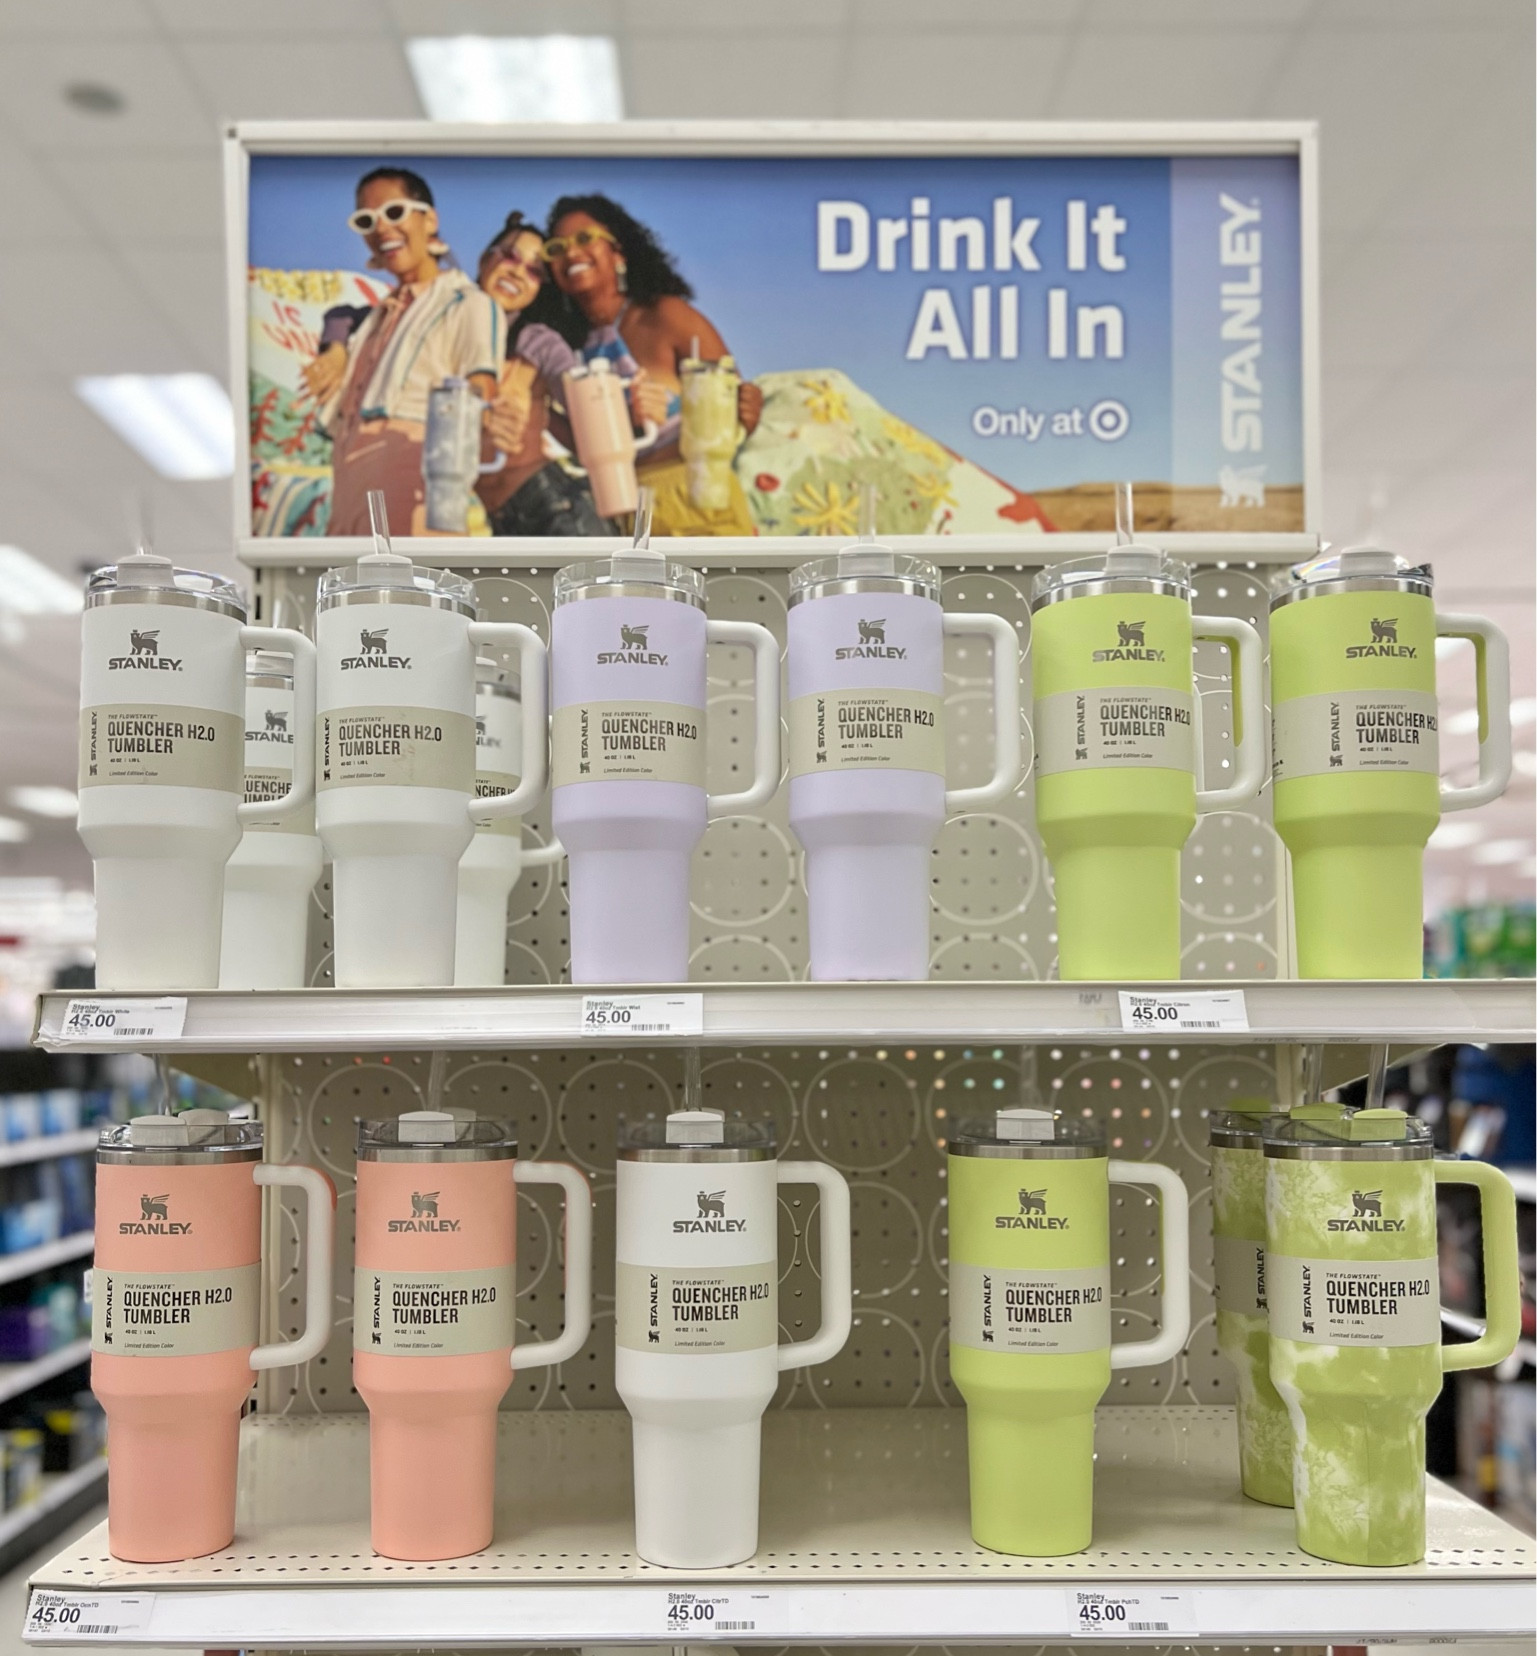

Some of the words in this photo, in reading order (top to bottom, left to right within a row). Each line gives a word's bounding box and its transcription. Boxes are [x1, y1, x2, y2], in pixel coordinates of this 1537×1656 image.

[817, 196, 1042, 273] Drink
[1066, 199, 1127, 273] It
[906, 285, 1020, 360] All
[1048, 288, 1125, 360] In
[1219, 192, 1263, 453] STANLEY
[972, 406, 1046, 443] Only
[1052, 408, 1084, 437] at
[597, 653, 668, 665] STANLEY
[835, 647, 907, 660] STANLEY
[1092, 649, 1165, 662] STANLEY
[1346, 646, 1417, 659] STANLEY
[108, 657, 183, 671] STANLEY
[340, 657, 412, 670] STANLEY
[838, 707, 911, 723] QUENCHER
[914, 710, 934, 727] H2.0
[1076, 696, 1085, 744] STANLEY
[1100, 705, 1172, 721] QUENCHER
[1356, 711, 1425, 728] QUENCHER
[602, 719, 674, 735] QUENCHER
[677, 723, 697, 739] H2.0
[817, 698, 825, 748] STANLEY
[1100, 723, 1165, 737] TUMBLER
[1331, 702, 1339, 752] STANLEY
[107, 721, 183, 738] QUENCHER
[187, 724, 215, 742] H2.0
[244, 731, 294, 744] STANLE
[339, 724, 410, 740] QUENCHER
[415, 725, 442, 741] H2.0
[580, 709, 588, 758] STANLEY
[838, 725, 903, 739] TUMBLER
[1356, 729, 1419, 744] TUMBLER
[107, 738, 173, 754] TUMBLER
[339, 741, 400, 757] TUMBLER
[602, 736, 666, 751] TUMBLER
[244, 780, 292, 794] UENCHE
[475, 785, 506, 797] NCHER
[72, 1004, 100, 1012] Stanley
[586, 1001, 613, 1009] Stanley
[69, 1014, 116, 1027] 45.00
[586, 1010, 631, 1023] 45.00
[1132, 1007, 1178, 1020] 45.00
[119, 1223, 193, 1235] STANLEY
[388, 1220, 461, 1232] STANLEY
[673, 1219, 746, 1233] STANLEY
[995, 1217, 1069, 1229] STANLEY
[1327, 1219, 1405, 1232] STANLEY
[1256, 1248, 1265, 1295] STANLEY
[672, 1286, 747, 1303] QUENCHER
[750, 1283, 769, 1299] H2.0
[1006, 1289, 1080, 1305] QUENCHER
[1083, 1287, 1102, 1304] H2.0
[1303, 1265, 1312, 1318] STANLEY
[1326, 1280, 1406, 1297] QUENCHER
[1409, 1280, 1430, 1296] H2.0
[105, 1277, 113, 1328] STANLEY
[124, 1291, 200, 1307] QUENCHER
[205, 1287, 232, 1304] H2.0
[373, 1276, 381, 1328] STANLEY
[393, 1291, 468, 1307] QUENCHER
[472, 1287, 496, 1304] H2.0
[649, 1274, 658, 1326] STANLEY
[983, 1275, 991, 1326] STANLEY
[672, 1305, 739, 1321] TUMBLER
[1326, 1298, 1398, 1315] TUMBLER
[124, 1308, 190, 1324] TUMBLER
[393, 1308, 459, 1324] TUMBLER
[1006, 1307, 1072, 1323] TUMBLER
[36, 1594, 66, 1603] Stanley
[1077, 1593, 1105, 1601] Stanley
[32, 1607, 80, 1623] 45.00
[668, 1604, 714, 1620] 45.00
[1079, 1605, 1126, 1620] 45.00
